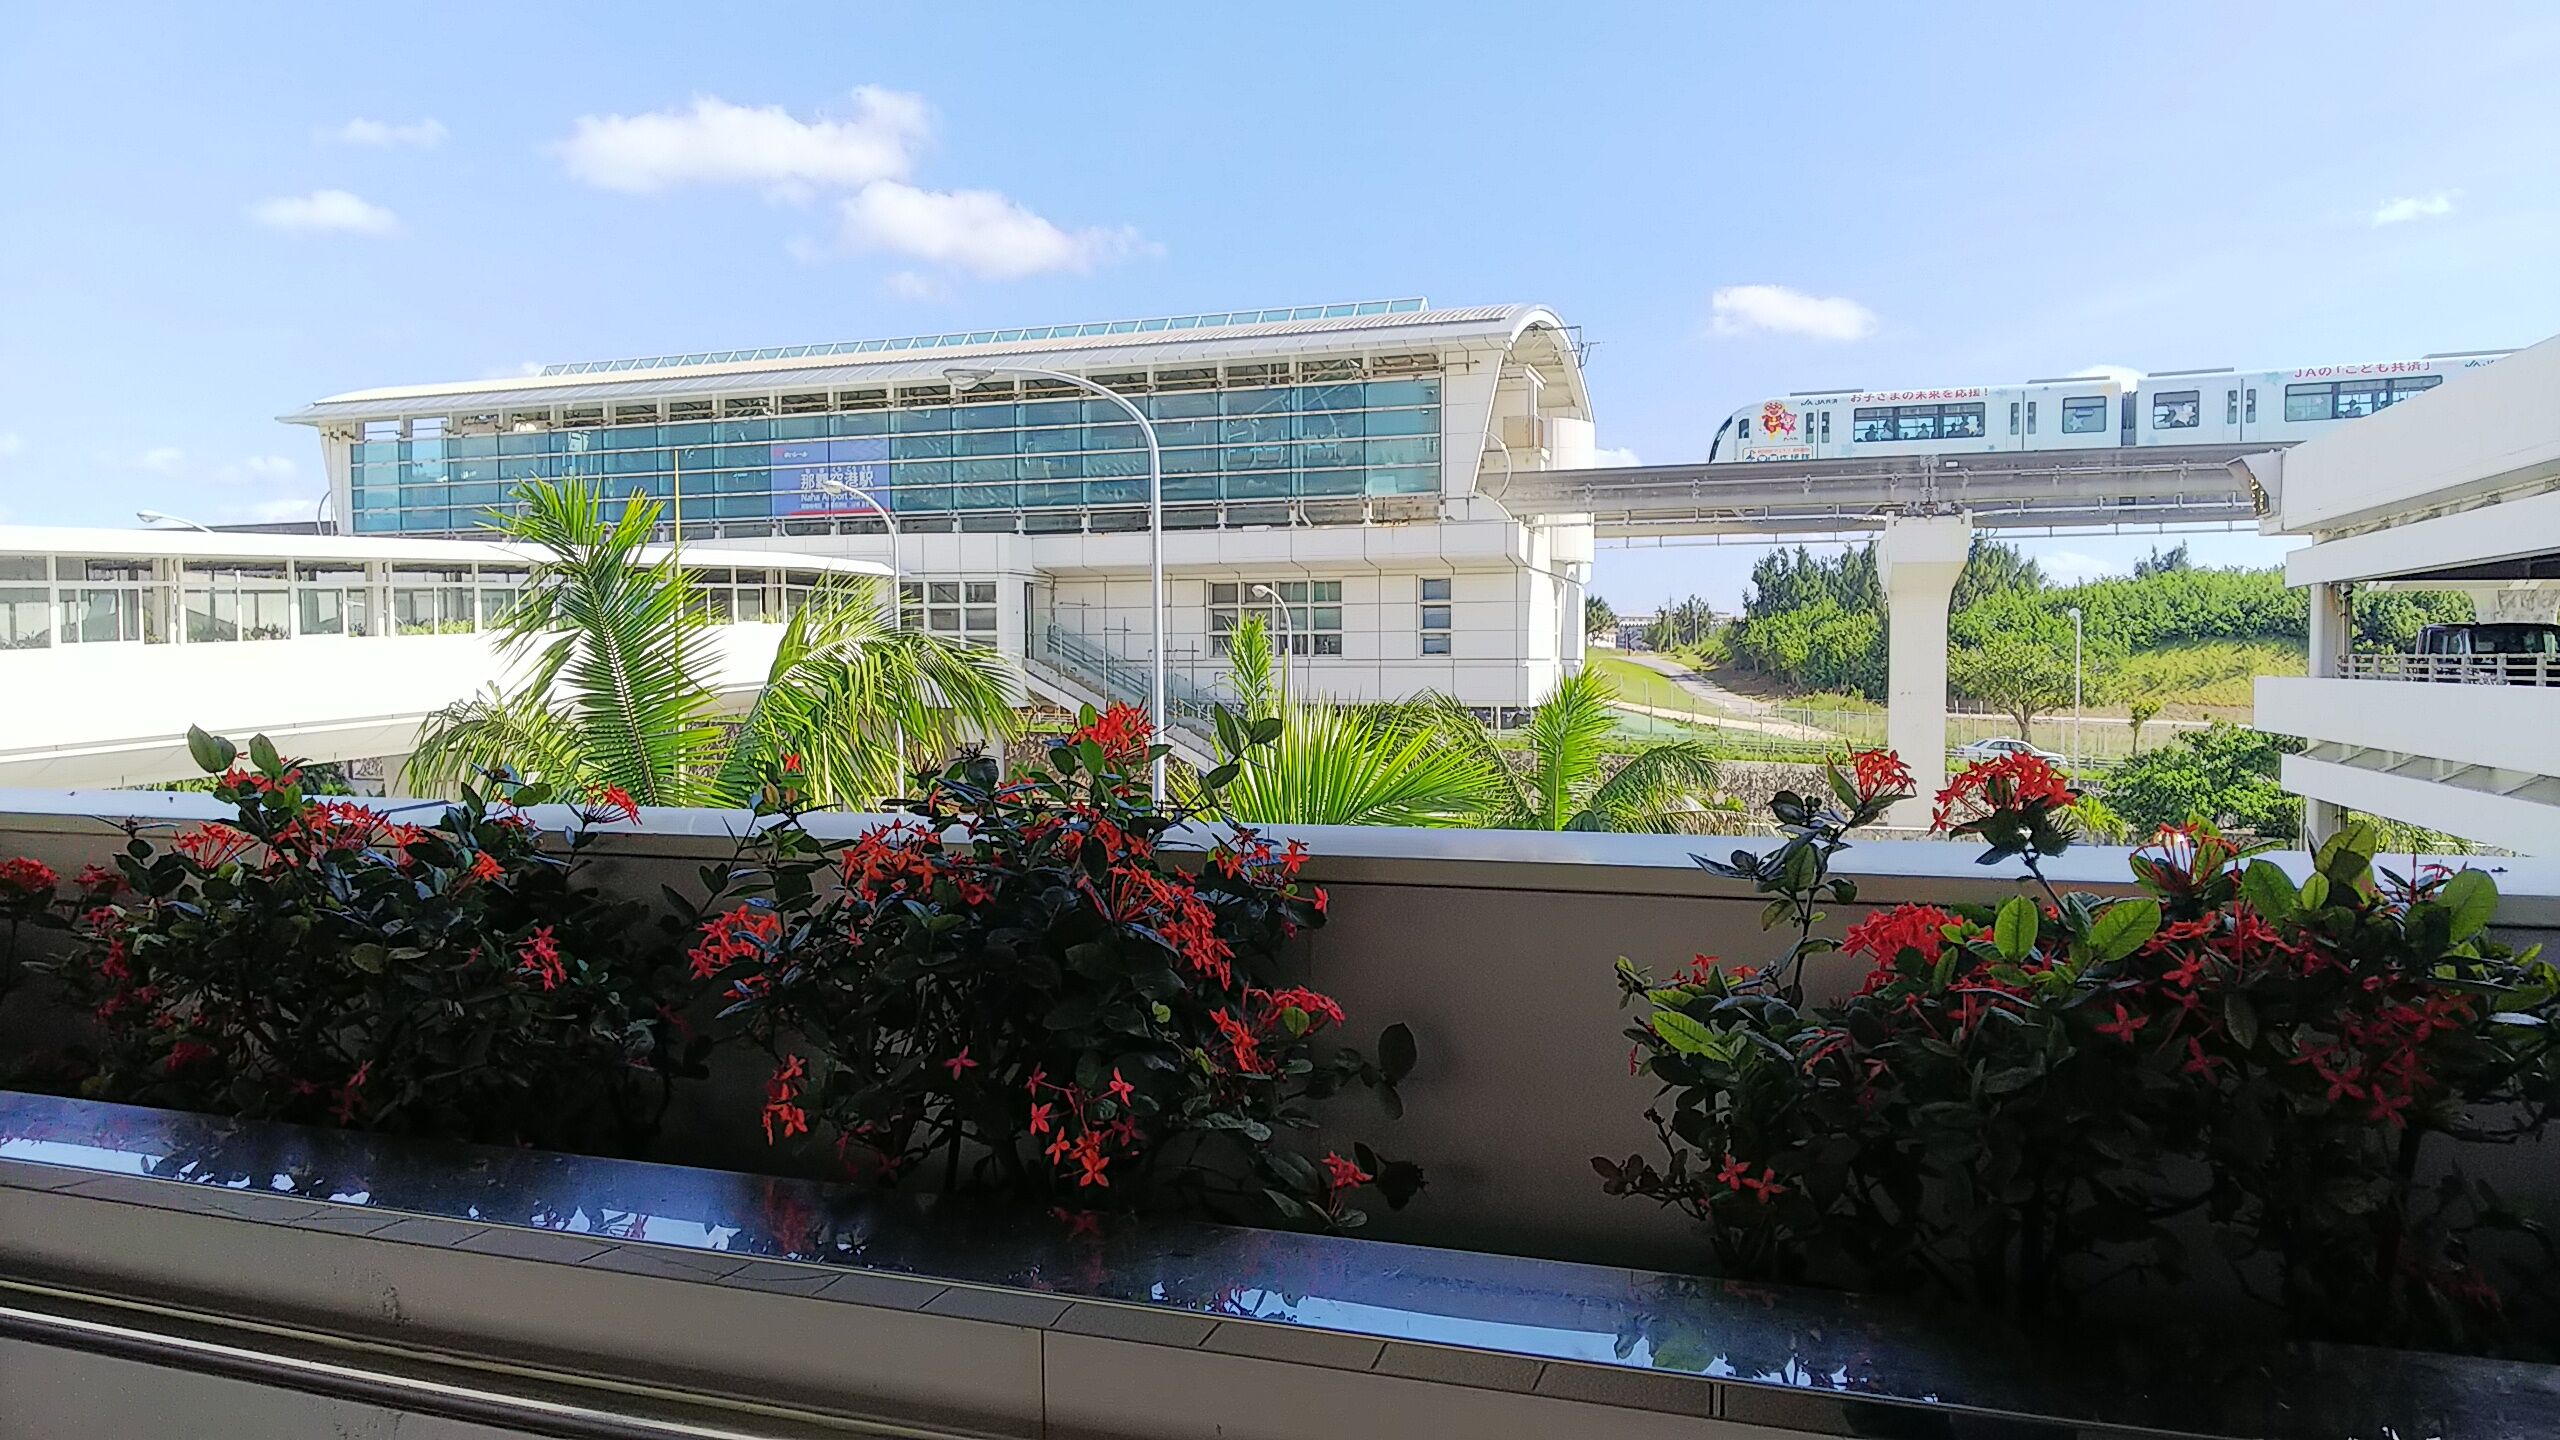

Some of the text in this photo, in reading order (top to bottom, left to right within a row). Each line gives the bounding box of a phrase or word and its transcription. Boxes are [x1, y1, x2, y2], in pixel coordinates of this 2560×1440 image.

[2295, 361, 2430, 378] JAの「こども共済」
[800, 492, 821, 502] Naha
